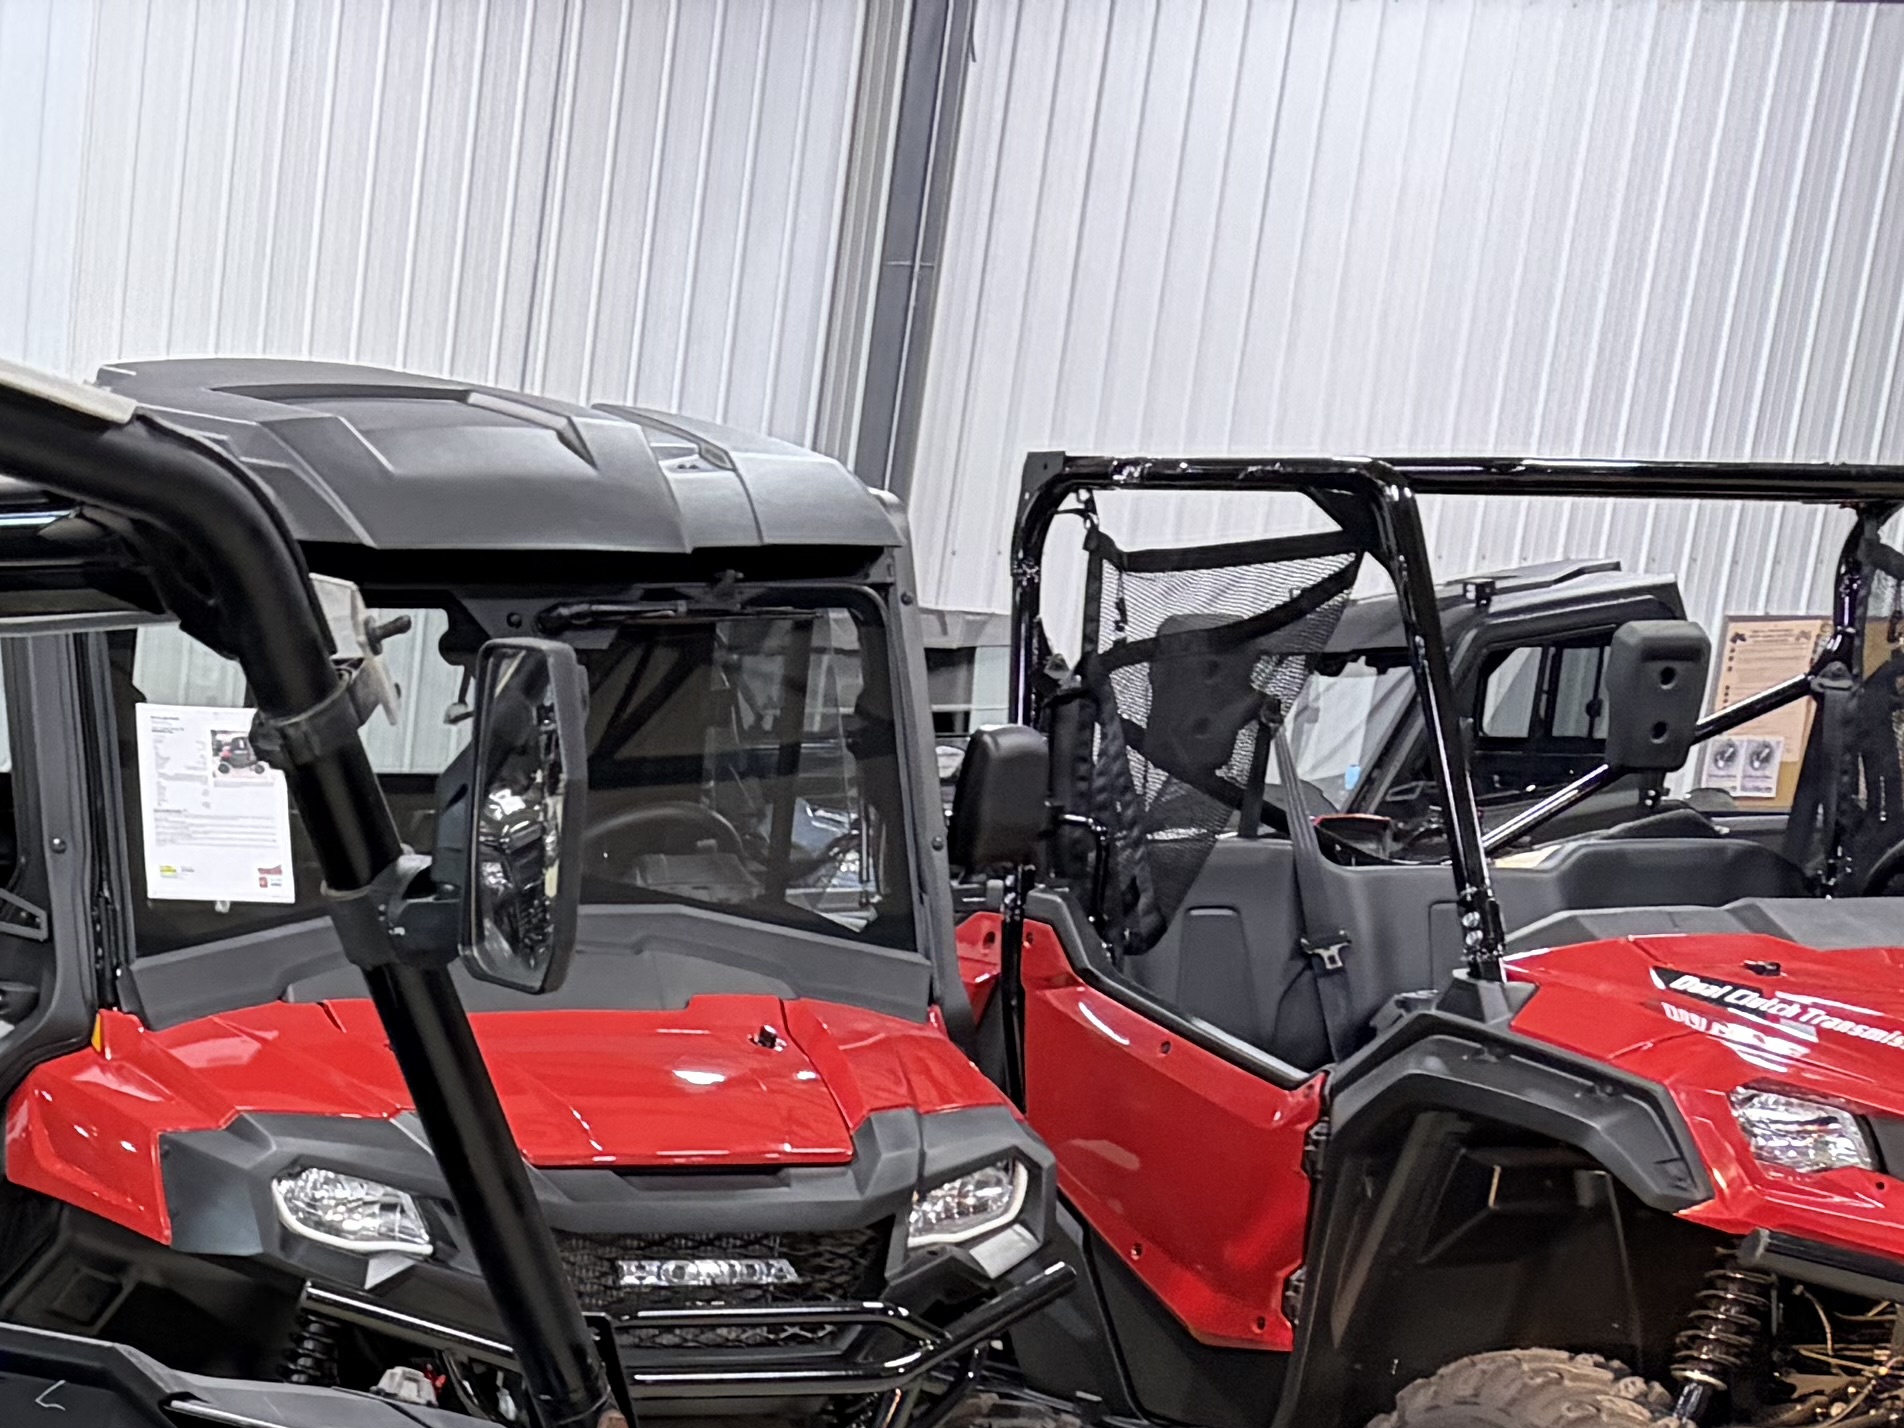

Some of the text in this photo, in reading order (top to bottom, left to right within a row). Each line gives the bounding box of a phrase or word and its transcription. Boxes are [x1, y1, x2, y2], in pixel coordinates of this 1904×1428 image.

[1669, 974, 1733, 999] Dual
[1727, 988, 1802, 1020] Clutch
[618, 1259, 801, 1286] HONDA
